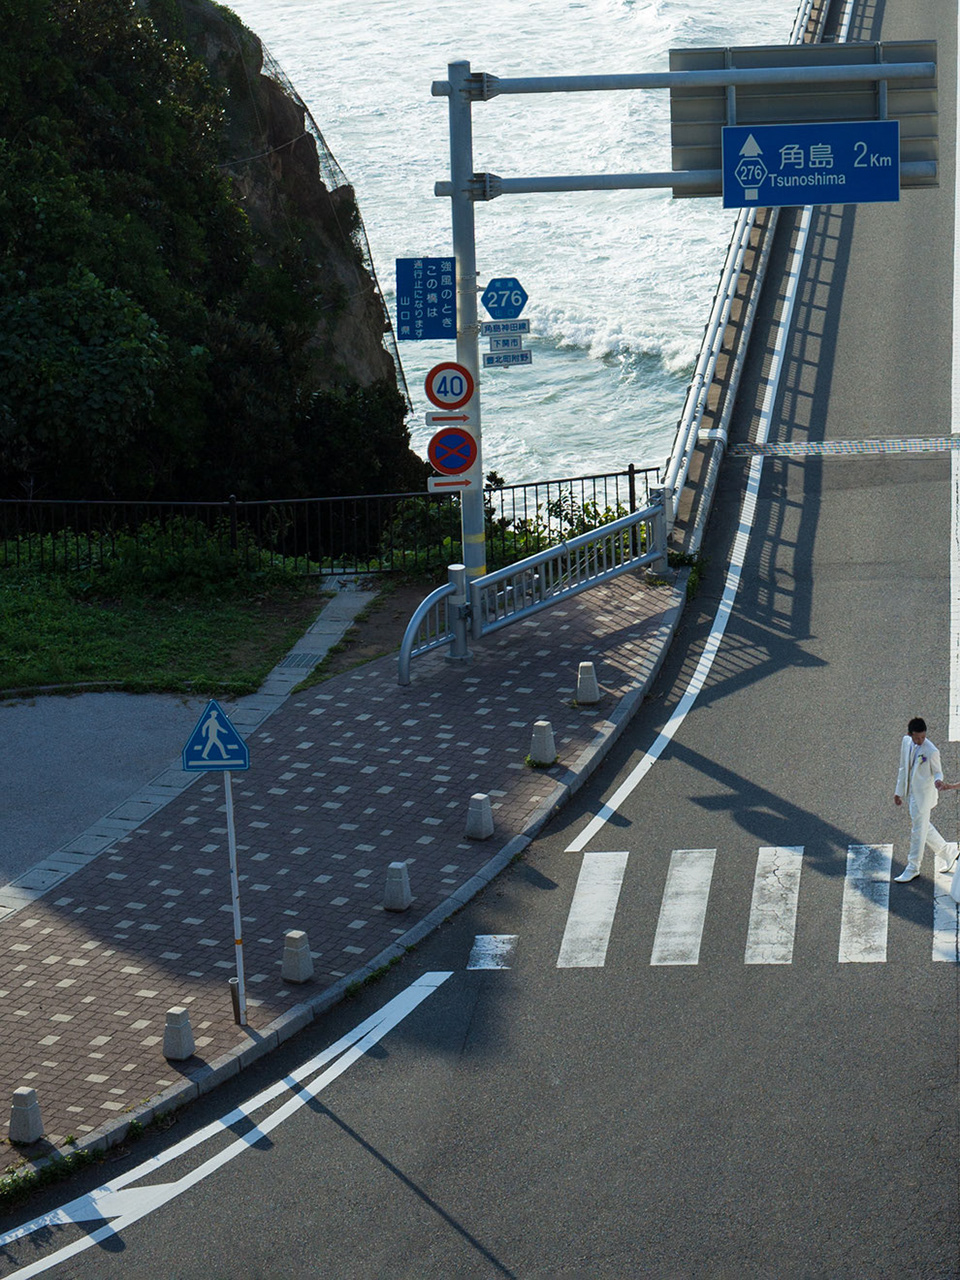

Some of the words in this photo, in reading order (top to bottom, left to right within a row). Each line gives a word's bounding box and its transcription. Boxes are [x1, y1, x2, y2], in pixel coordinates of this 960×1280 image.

[779, 143, 834, 170] 角島
[740, 165, 762, 180] 276
[768, 172, 846, 187] Tsunoshima
[413, 260, 424, 338] 通行止になります
[426, 265, 438, 318] この橋は
[441, 261, 453, 328] 強風のとき
[487, 290, 522, 307] 276
[400, 296, 410, 335] 山口県
[436, 375, 463, 397] 40
